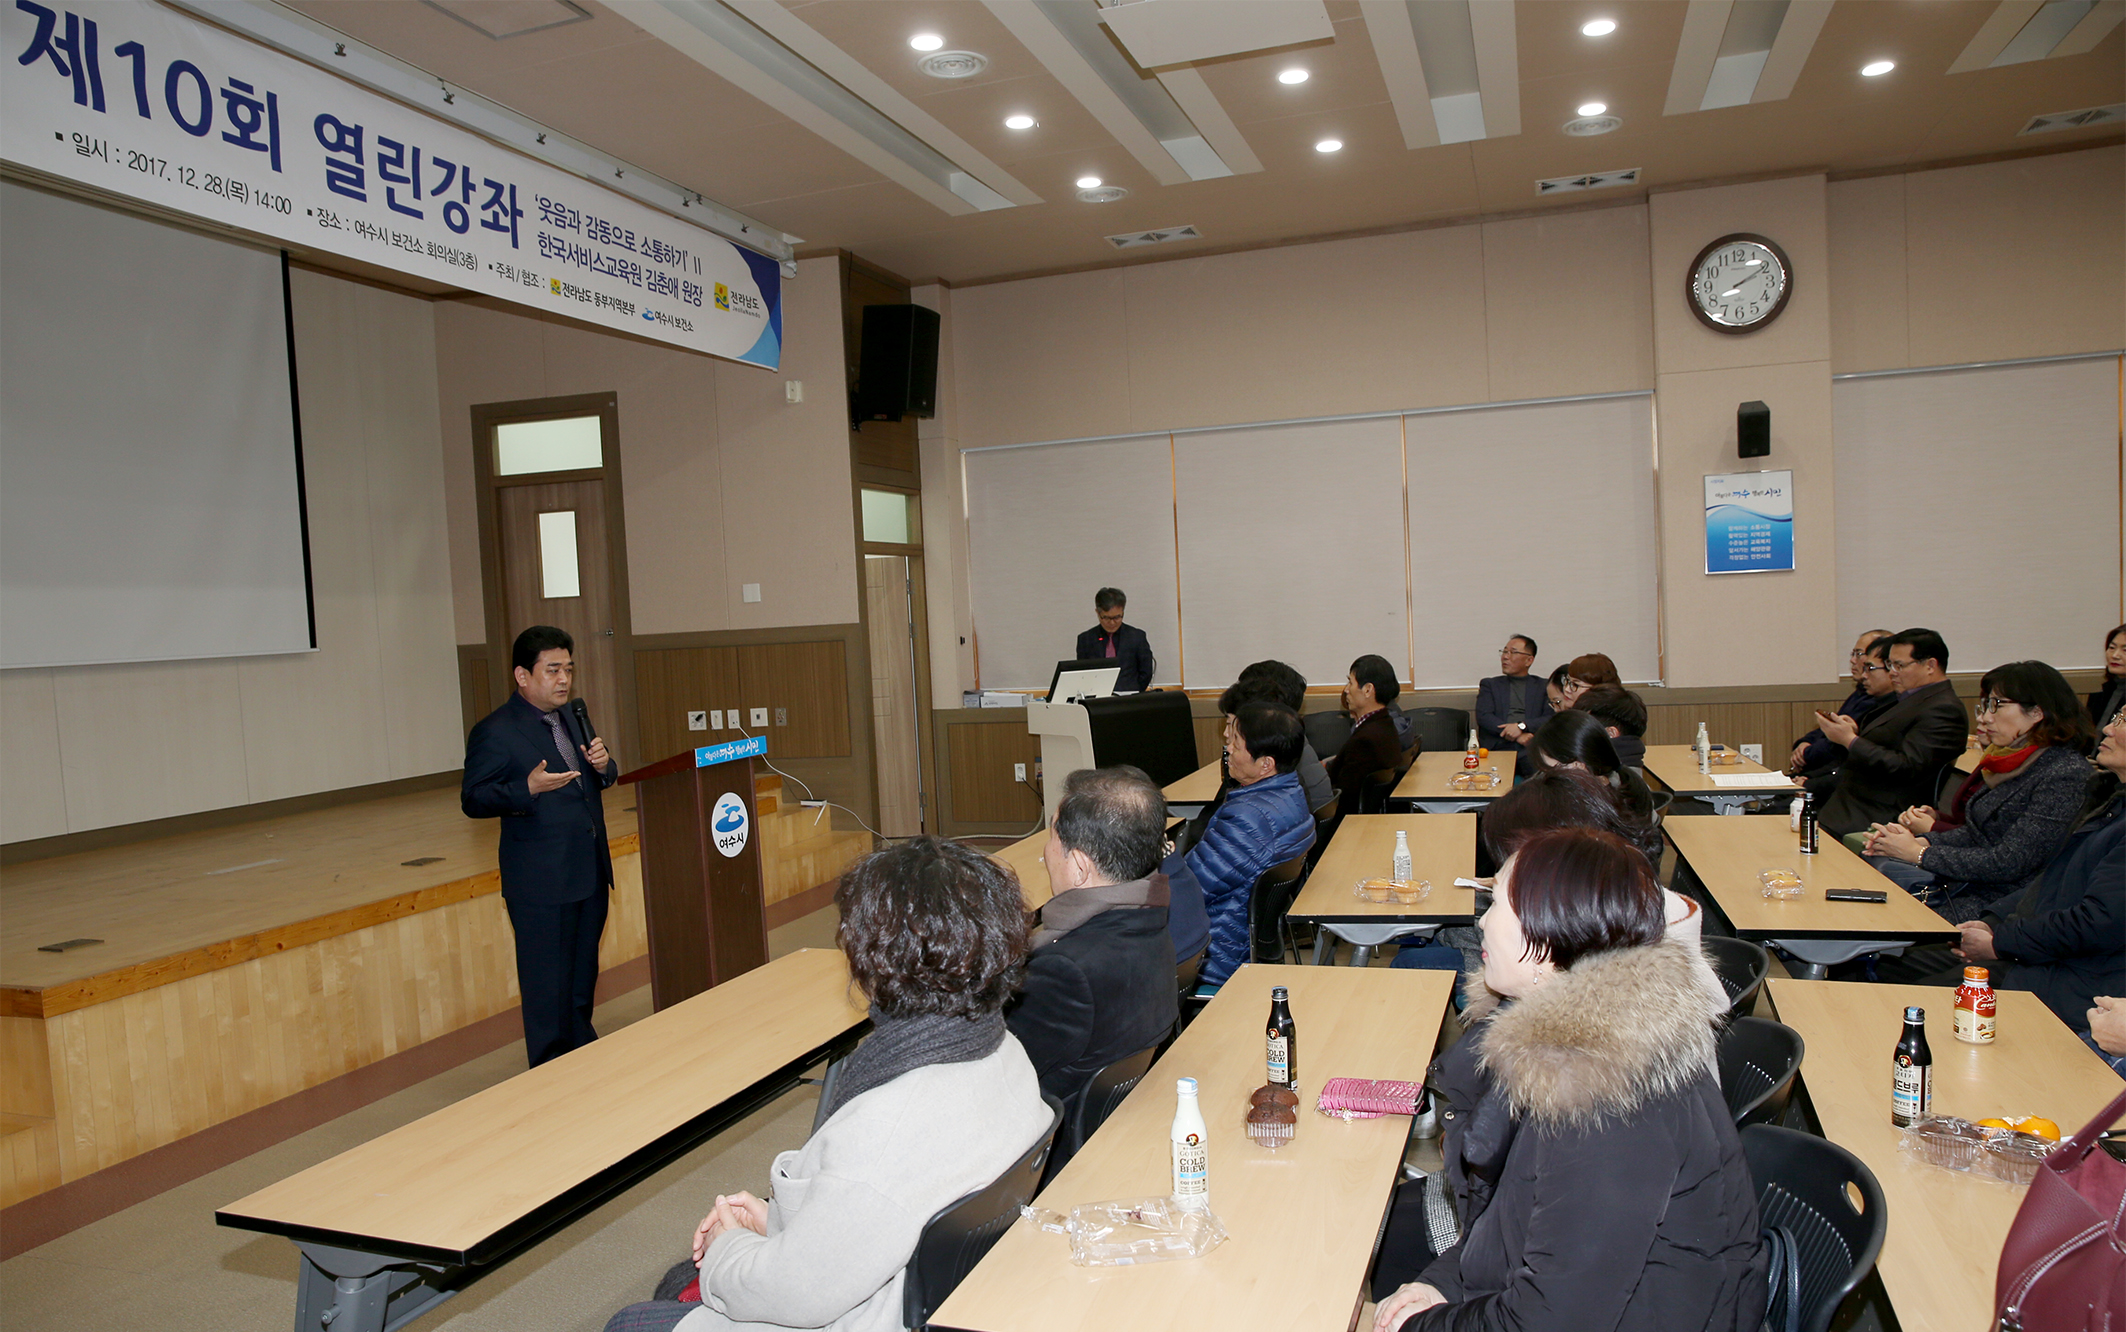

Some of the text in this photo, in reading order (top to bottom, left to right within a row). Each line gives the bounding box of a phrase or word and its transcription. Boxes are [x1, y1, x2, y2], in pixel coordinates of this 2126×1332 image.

[16, 0, 524, 249] 제10회 열린강좌
[72, 132, 108, 163] 일시
[128, 150, 171, 182] 2017.
[178, 166, 199, 190] 12.
[204, 173, 249, 205] 28.(목)
[254, 189, 292, 215] 14:00
[317, 207, 342, 230] 장소
[354, 219, 389, 246] 여수시
[391, 231, 424, 255] 보건소
[427, 241, 478, 272] 회의실(3층)
[585, 215, 637, 253] 감동으로
[1718, 254, 1729, 267] 11
[1732, 249, 1746, 263] 12
[537, 231, 703, 308] 한국서비스교육원 김춘애 원장
[1706, 266, 1719, 279] 10
[1761, 260, 1770, 274] 2
[1703, 281, 1713, 294] 9
[1765, 275, 1776, 288] 3
[496, 262, 515, 282] 주최
[521, 269, 540, 289] 협조
[562, 282, 593, 303] 전라남도
[594, 292, 636, 316] 동부지역본부
[730, 290, 760, 310] 전라남도
[1708, 294, 1718, 308] 8
[1760, 290, 1770, 303] 4
[1720, 304, 1729, 317] 7
[1734, 306, 1745, 320] 6
[1750, 301, 1759, 315] 5
[654, 310, 695, 332] 여수시 보건소
[745, 739, 760, 754] 시민
[719, 832, 744, 849] 여수시
[1180, 1157, 1205, 1166] COLD
[1180, 1163, 1206, 1173] BREW
